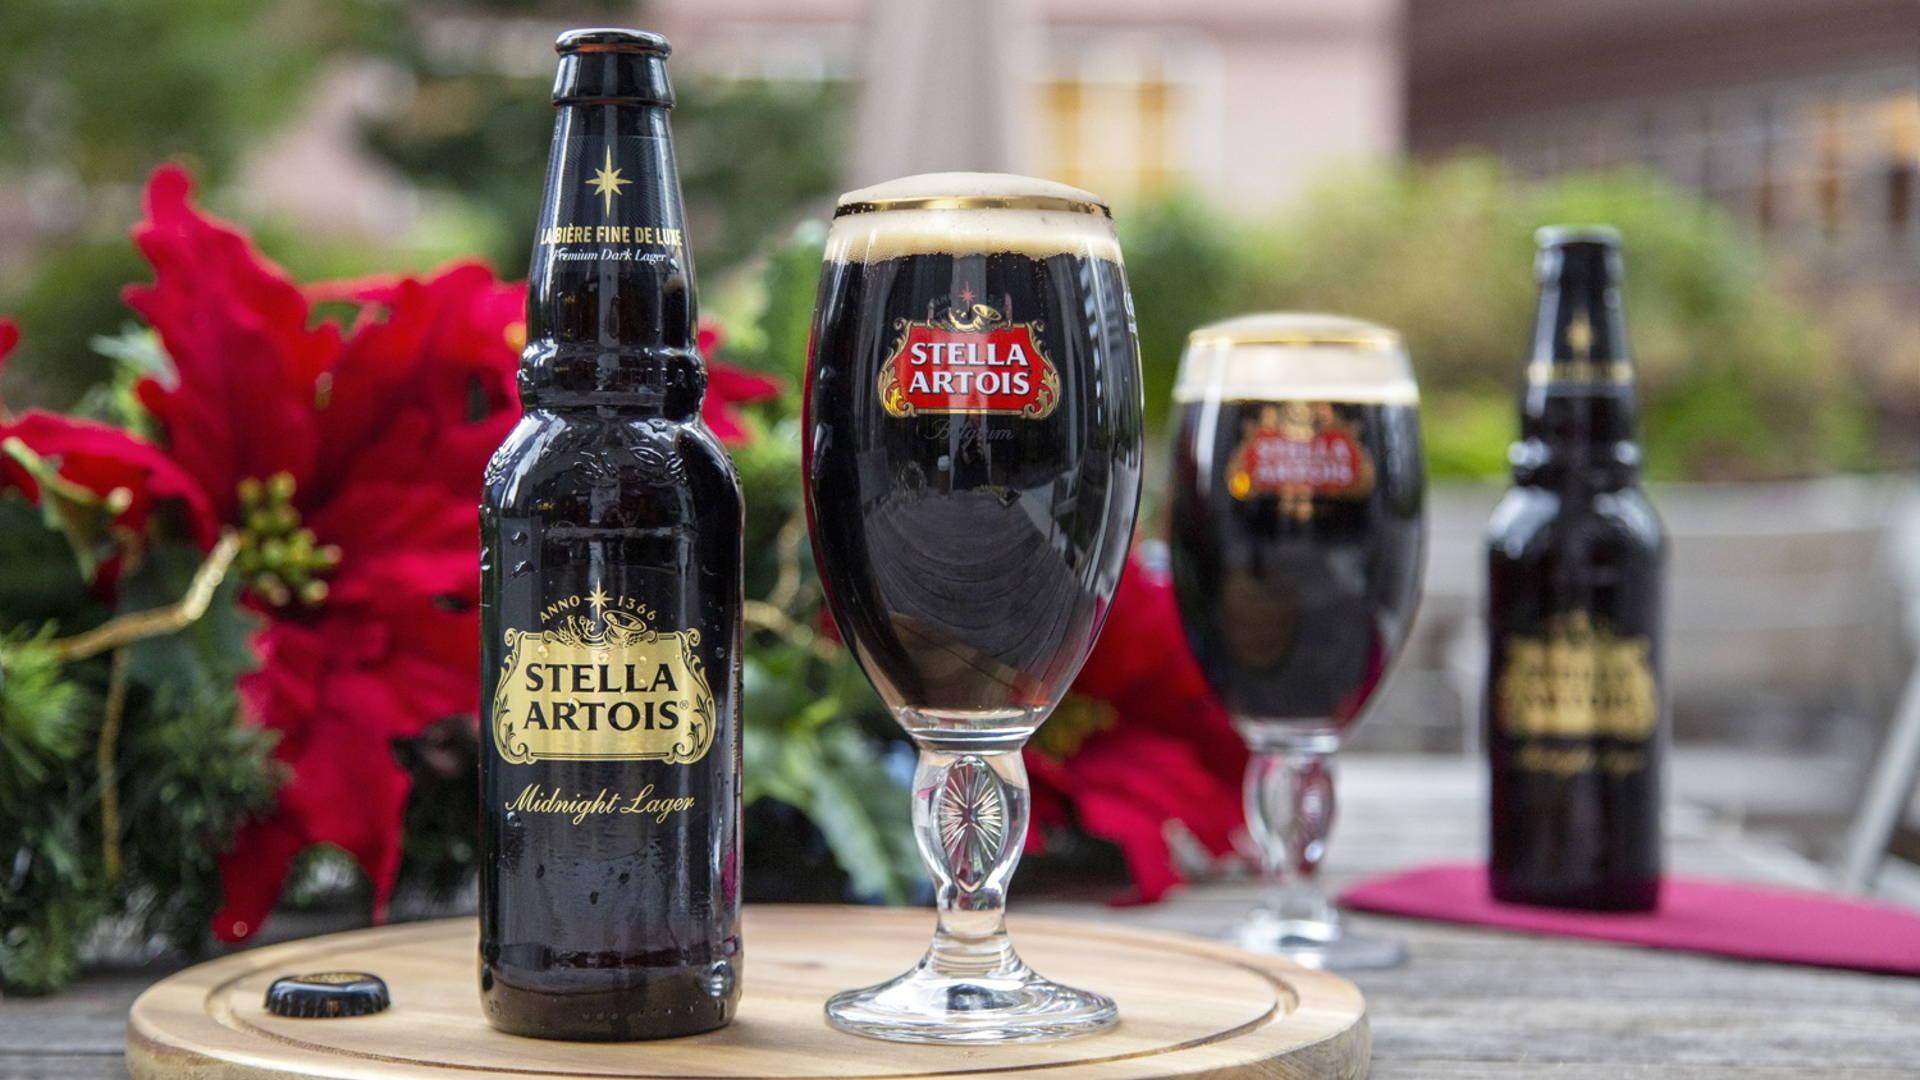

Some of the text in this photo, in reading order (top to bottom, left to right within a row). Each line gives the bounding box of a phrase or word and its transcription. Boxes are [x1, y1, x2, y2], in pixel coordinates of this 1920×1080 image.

[541, 223, 682, 246] LA BIÈRE FINE DE LUXE
[552, 248, 667, 266] Premium Dark Lager
[911, 342, 1028, 366] STELLA
[909, 371, 1030, 395] ARTOIS
[923, 418, 1016, 448] Blgum
[539, 595, 657, 624] ANNO 1366
[525, 663, 678, 693] STELLA
[505, 783, 695, 825] Midnight Lager
